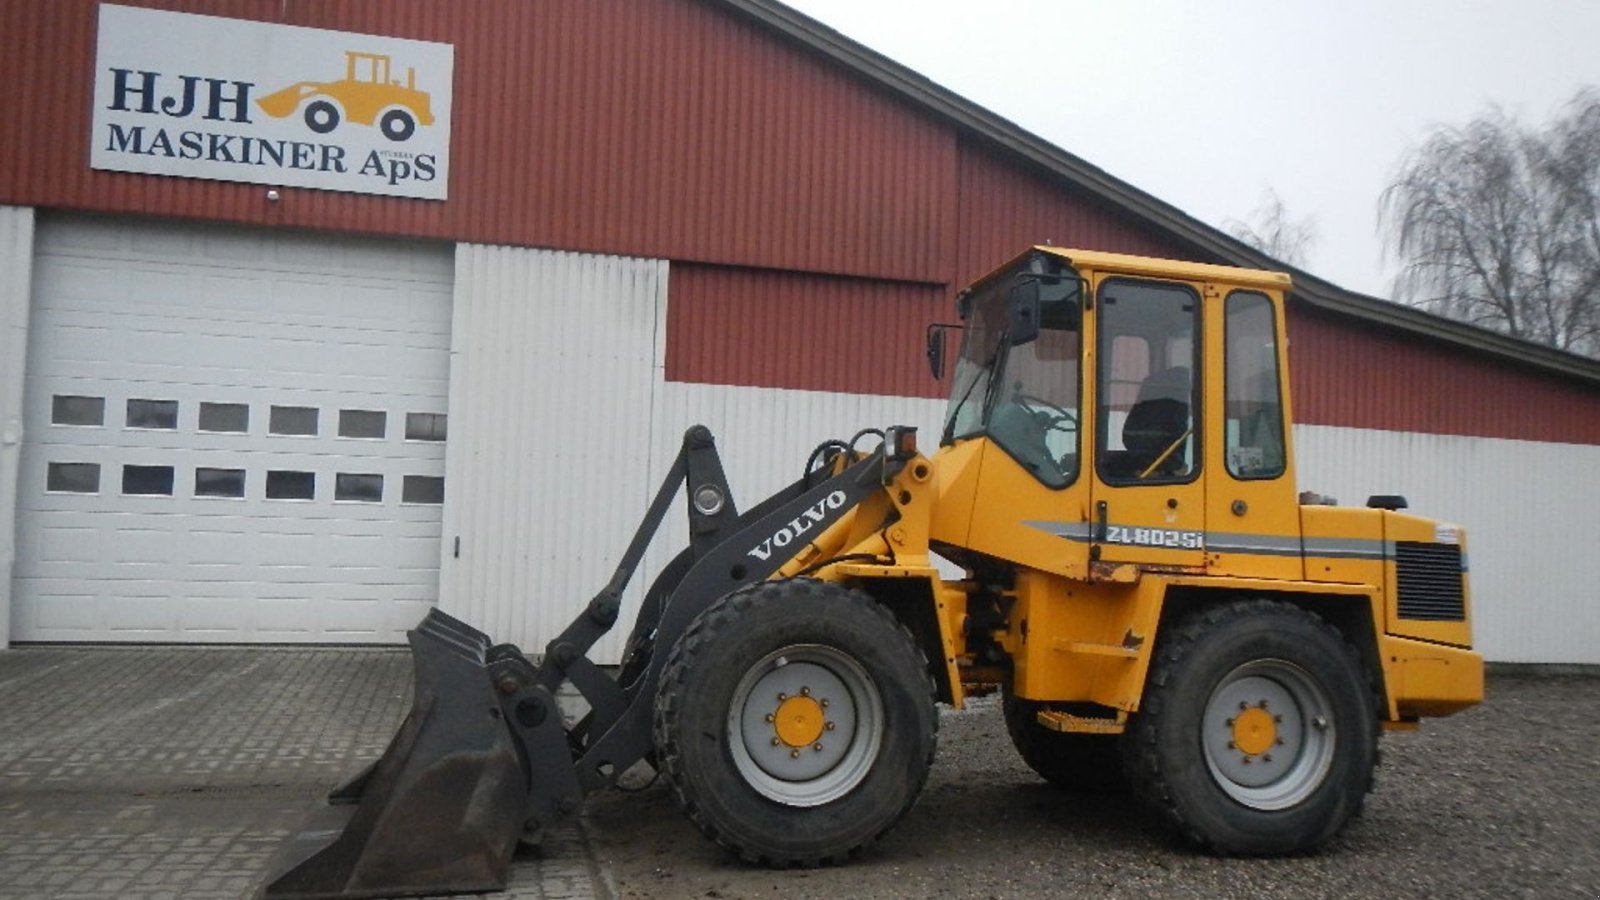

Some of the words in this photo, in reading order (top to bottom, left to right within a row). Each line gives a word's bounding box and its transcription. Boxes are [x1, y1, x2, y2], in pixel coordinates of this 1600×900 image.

[106, 67, 256, 124] HJH
[105, 123, 348, 174] MASKINER
[358, 149, 436, 186] ApS
[747, 490, 847, 560] VOLVO
